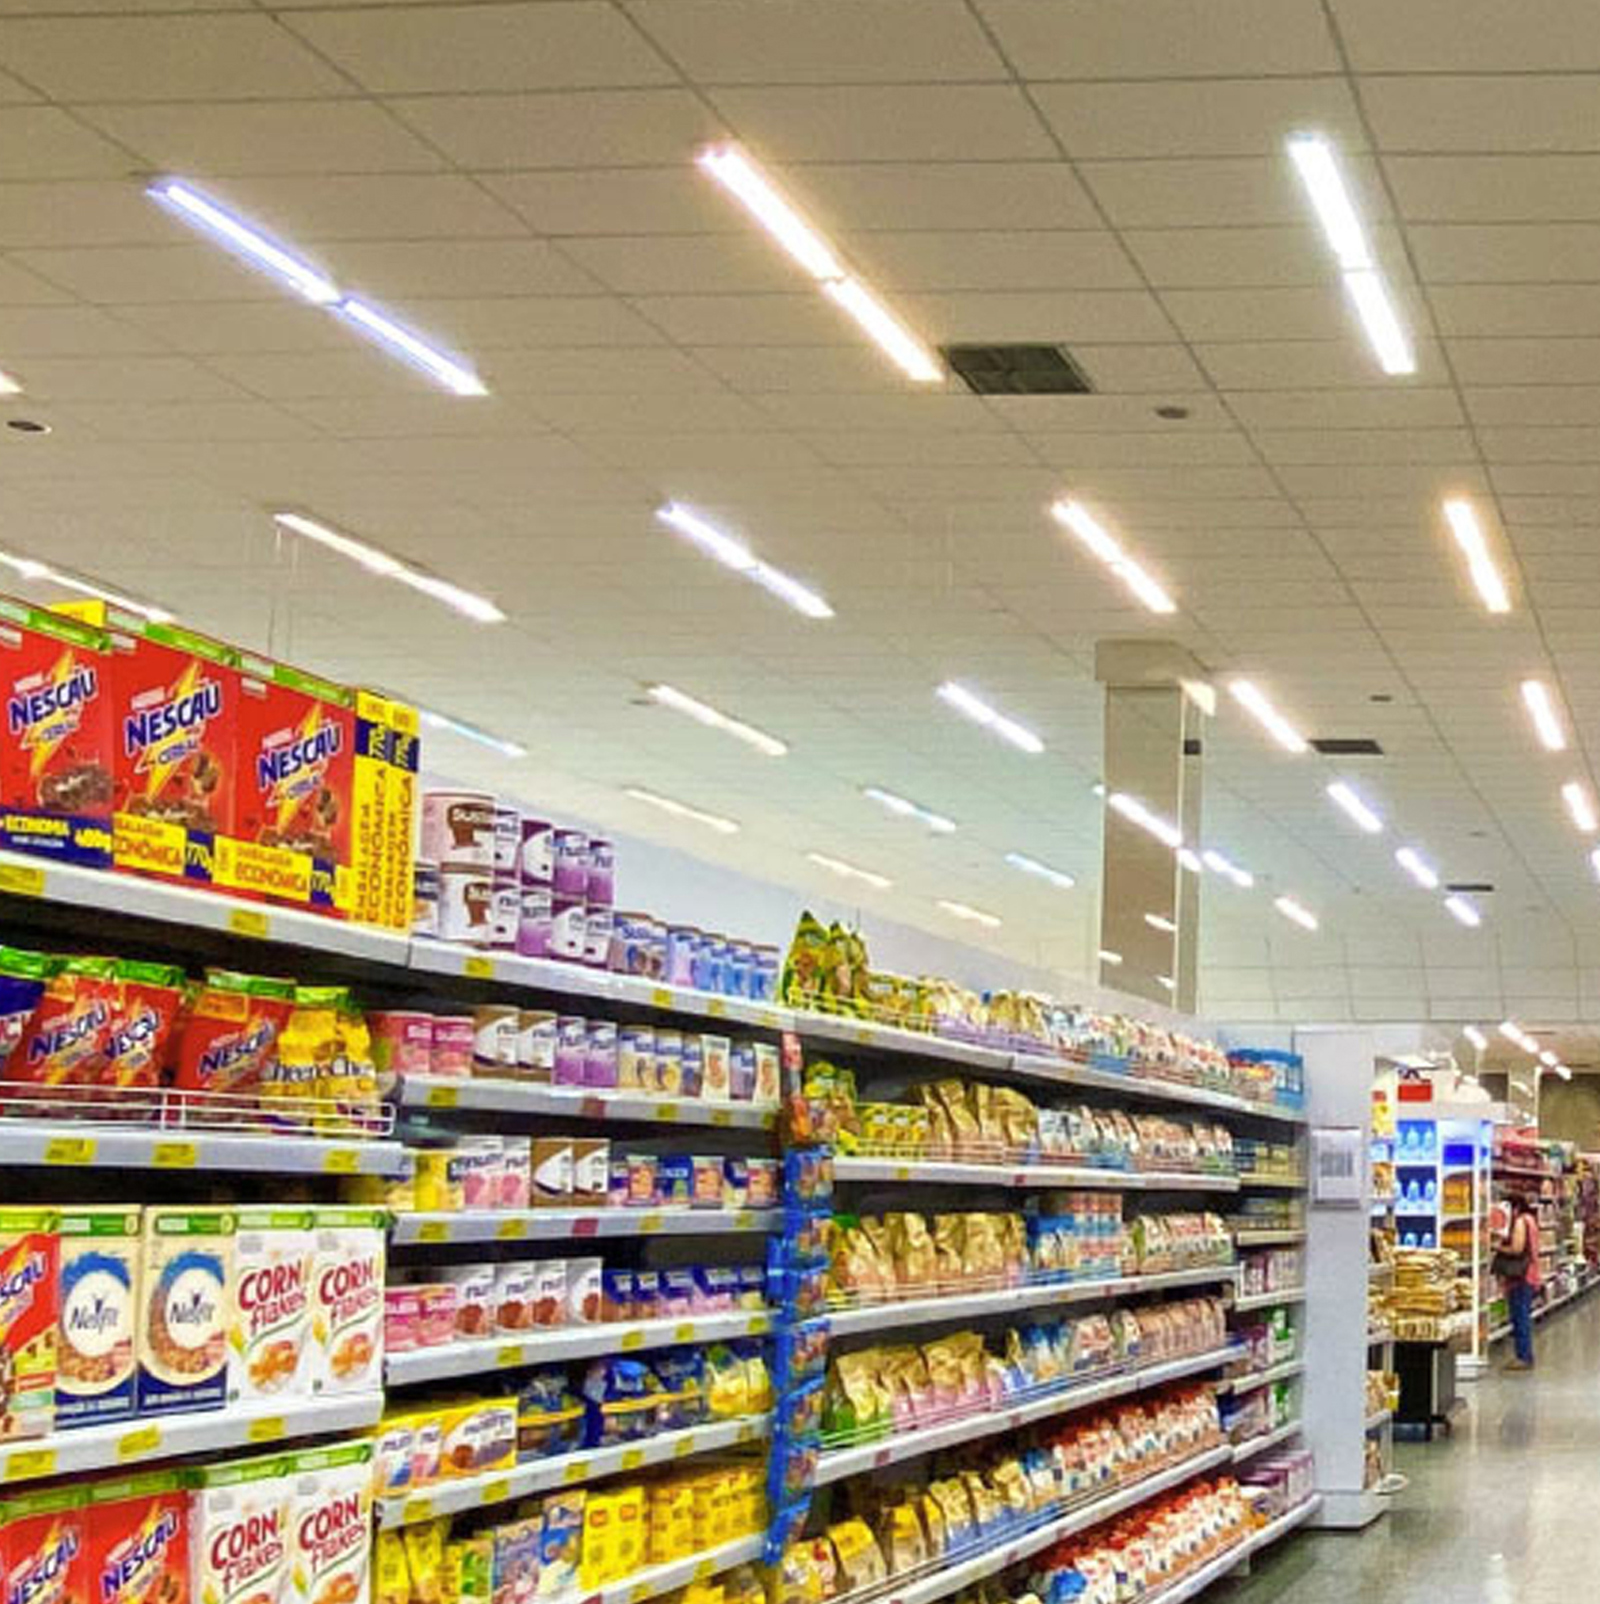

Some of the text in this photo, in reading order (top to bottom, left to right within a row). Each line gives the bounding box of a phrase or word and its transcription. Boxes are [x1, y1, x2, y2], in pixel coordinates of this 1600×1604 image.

[9, 668, 97, 734] NESCAU
[125, 682, 220, 757] NESCAU
[258, 724, 342, 791] NESCAU
[28, 1001, 106, 1062] NESCAU
[239, 1258, 302, 1311] CORN
[320, 1256, 374, 1306] CORN
[211, 1508, 278, 1570] CORN
[299, 1493, 358, 1550] CORN
[103, 1511, 178, 1600] NESCAU
